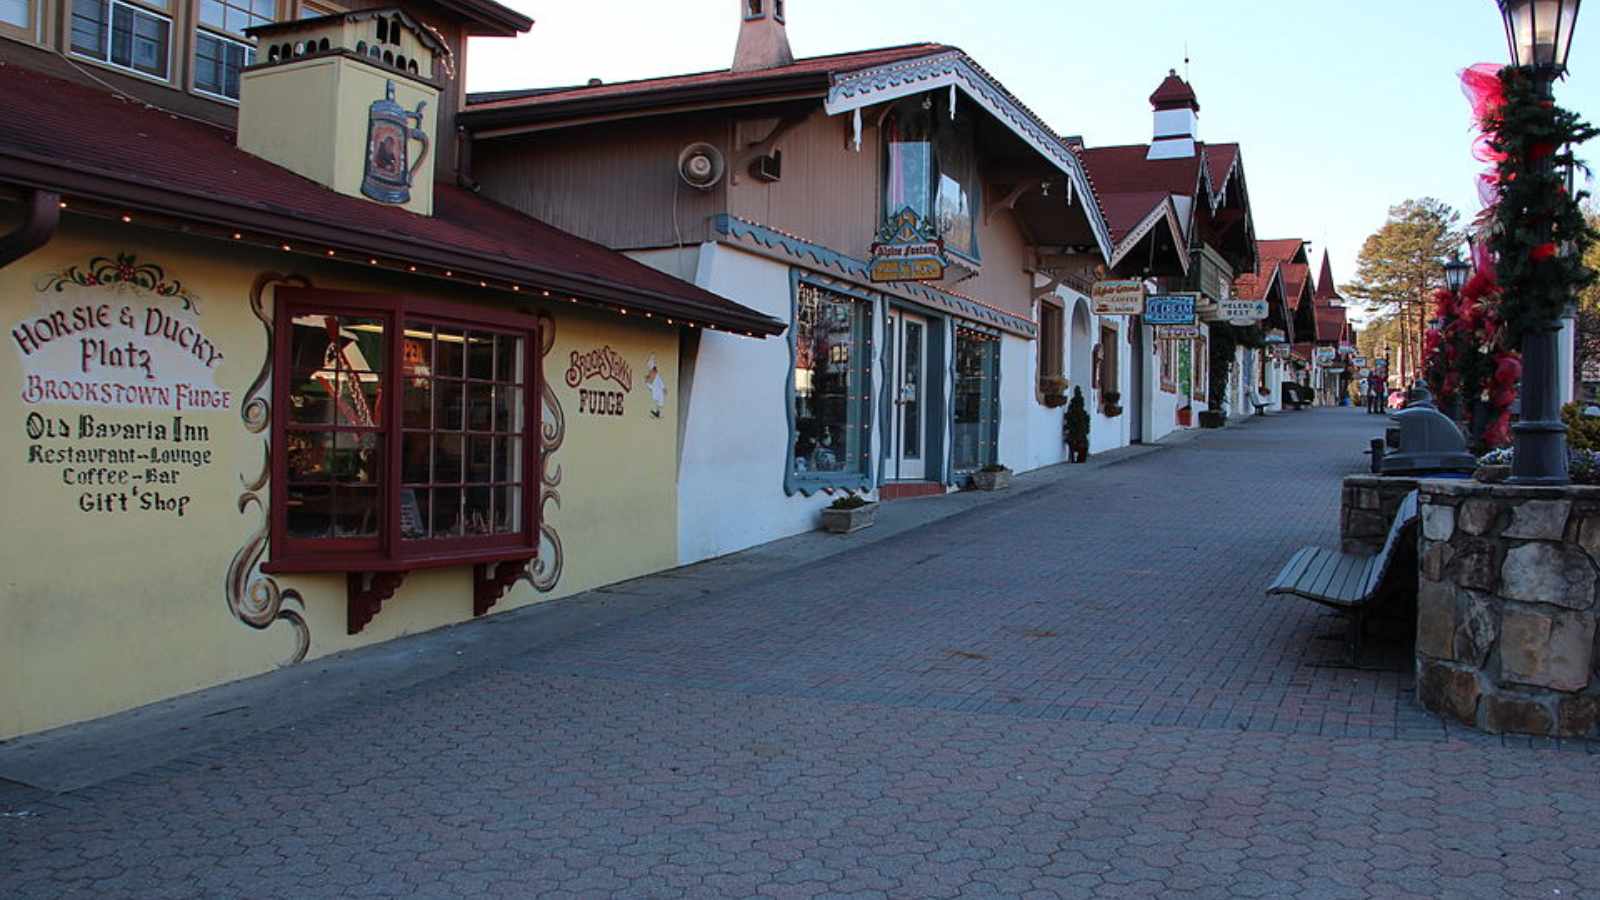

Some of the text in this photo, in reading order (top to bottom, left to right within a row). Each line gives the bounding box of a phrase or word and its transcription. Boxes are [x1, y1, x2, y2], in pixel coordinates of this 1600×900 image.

[1161, 303, 1192, 313] CREAM
[12, 304, 224, 369] HORSIE & DUCKY
[81, 337, 155, 379] Platz
[579, 388, 624, 416] FUDGE
[79, 414, 167, 440] Bavaria
[172, 416, 209, 442] Inn
[79, 492, 128, 512] Gift
